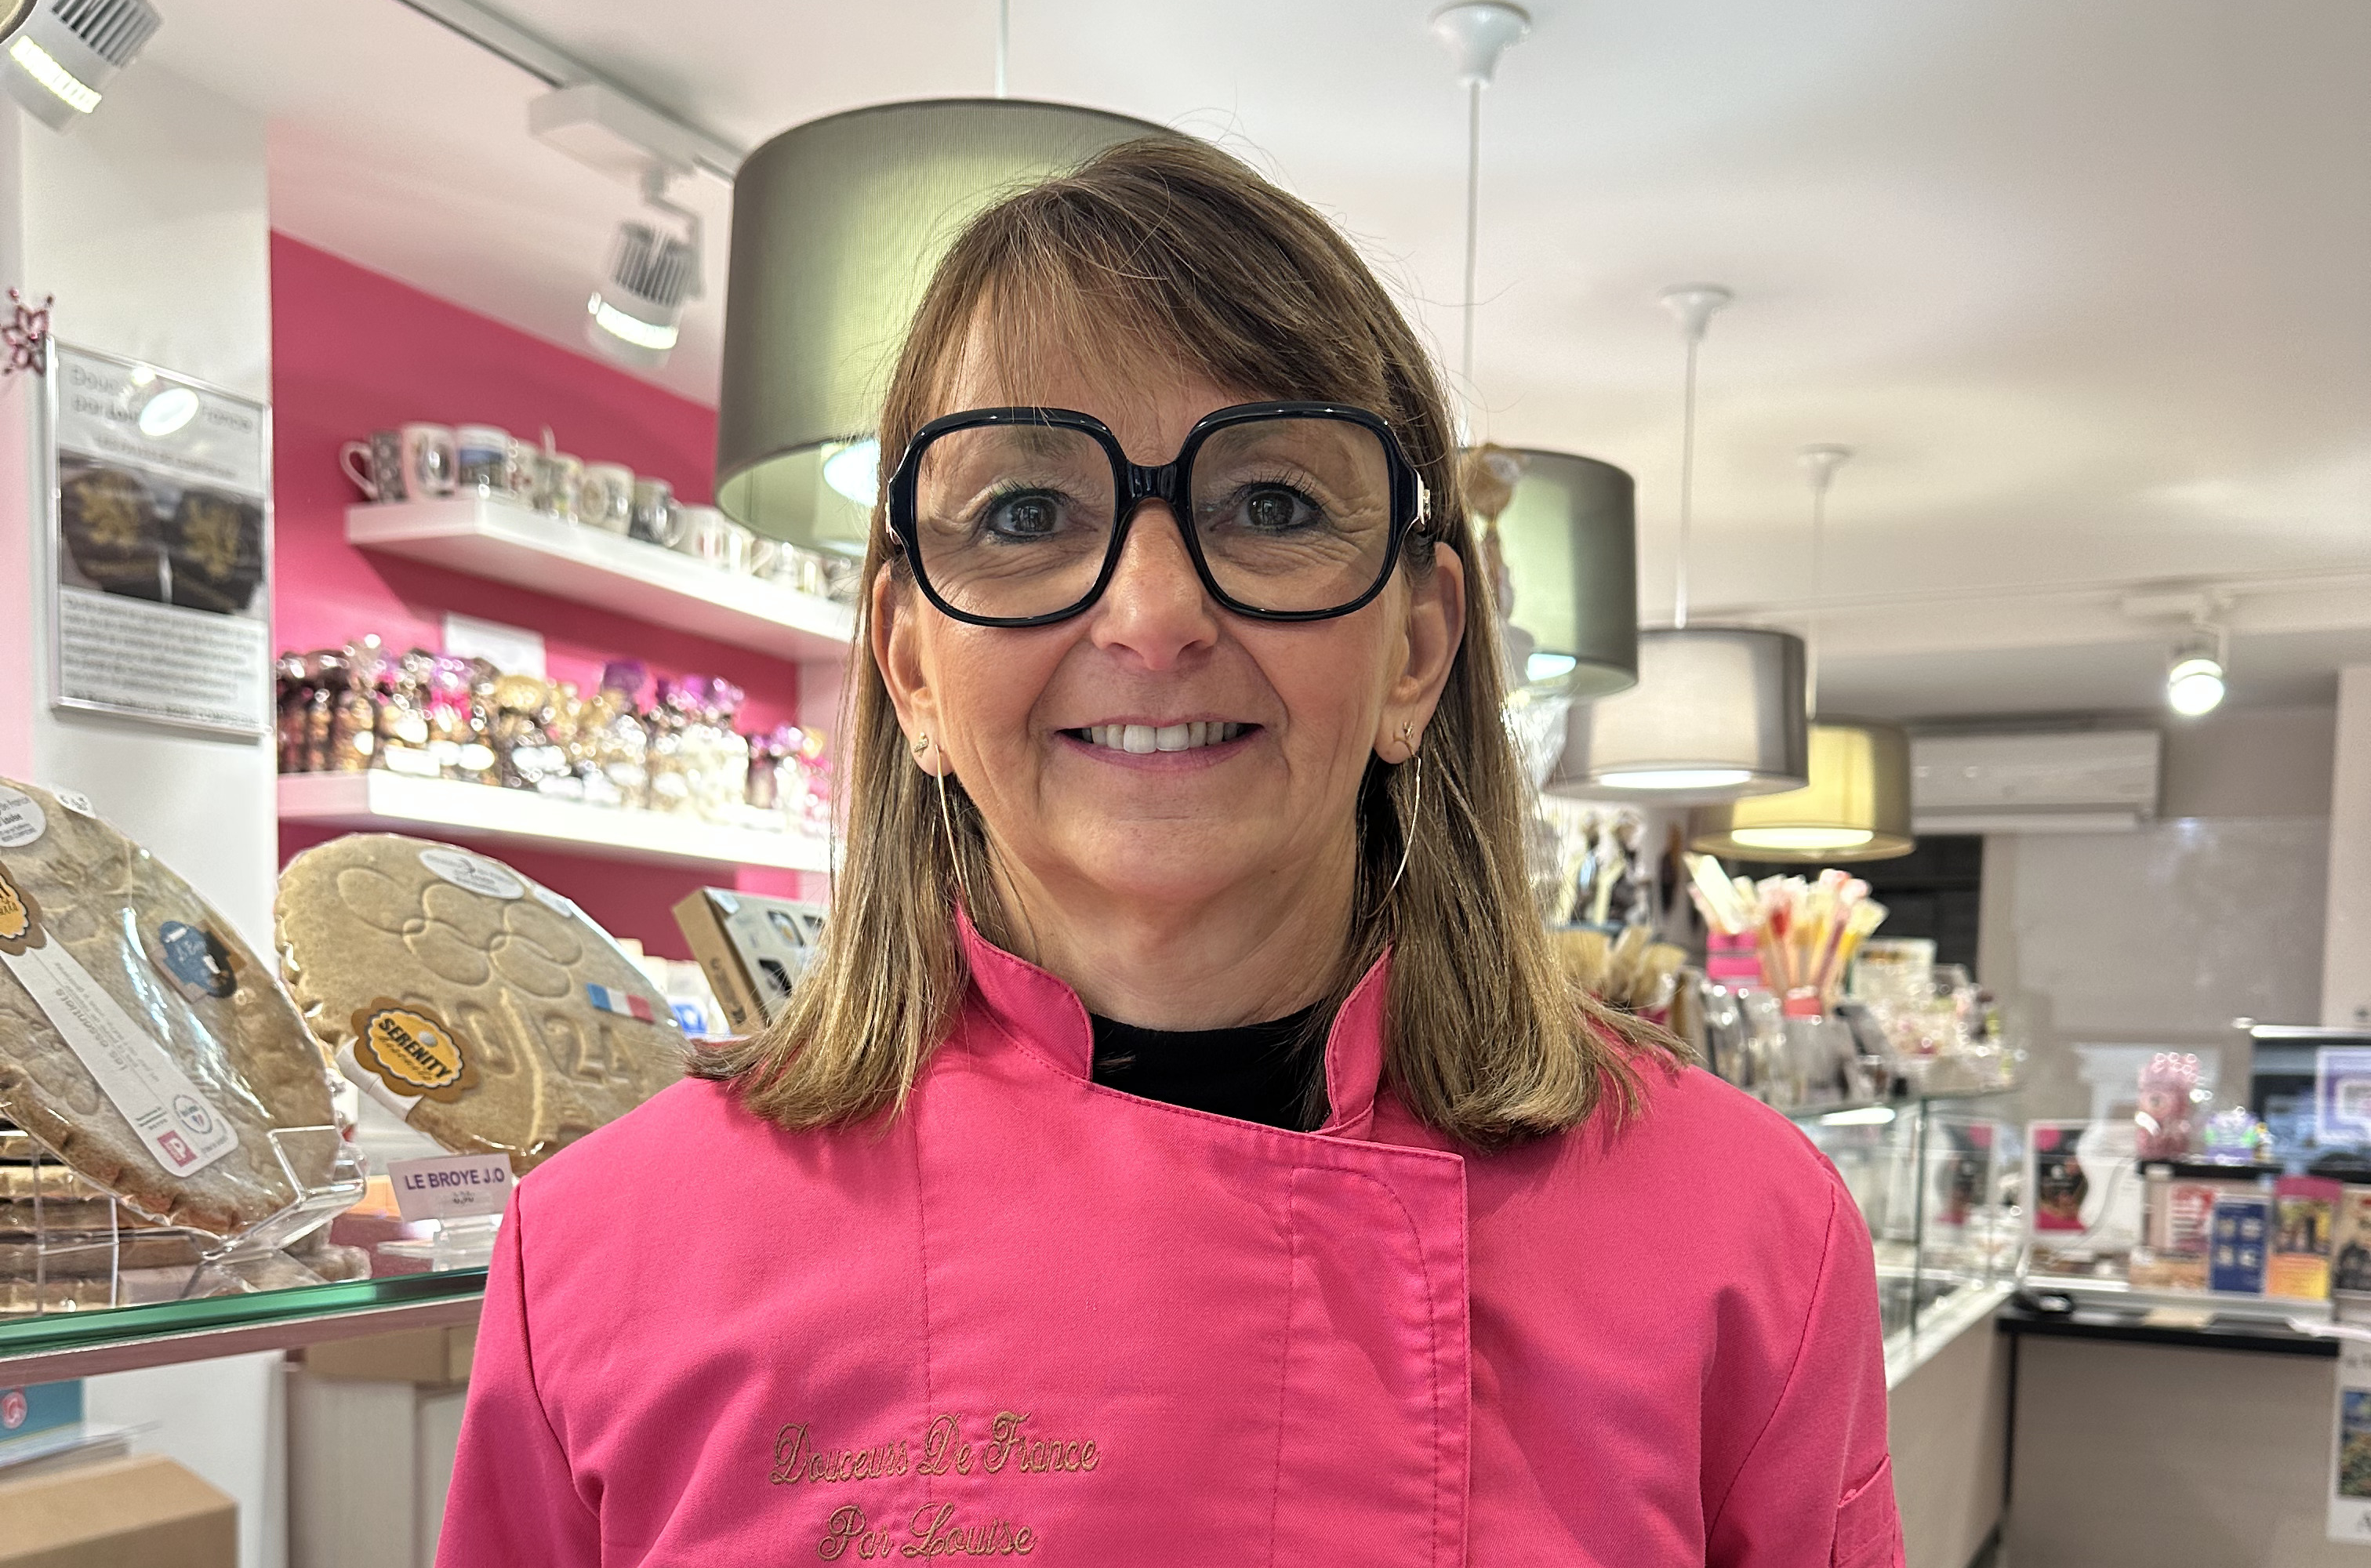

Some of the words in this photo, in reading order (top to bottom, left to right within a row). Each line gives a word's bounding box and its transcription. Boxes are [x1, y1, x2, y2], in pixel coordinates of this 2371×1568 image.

[378, 1018, 452, 1078] SERENITY
[405, 1174, 426, 1190] LE
[427, 1169, 481, 1189] BROYE
[768, 1421, 910, 1485] Douceurs
[917, 1410, 974, 1476] De
[982, 1410, 1100, 1474] France
[816, 1504, 895, 1562] Par
[901, 1501, 1038, 1562] Louise
